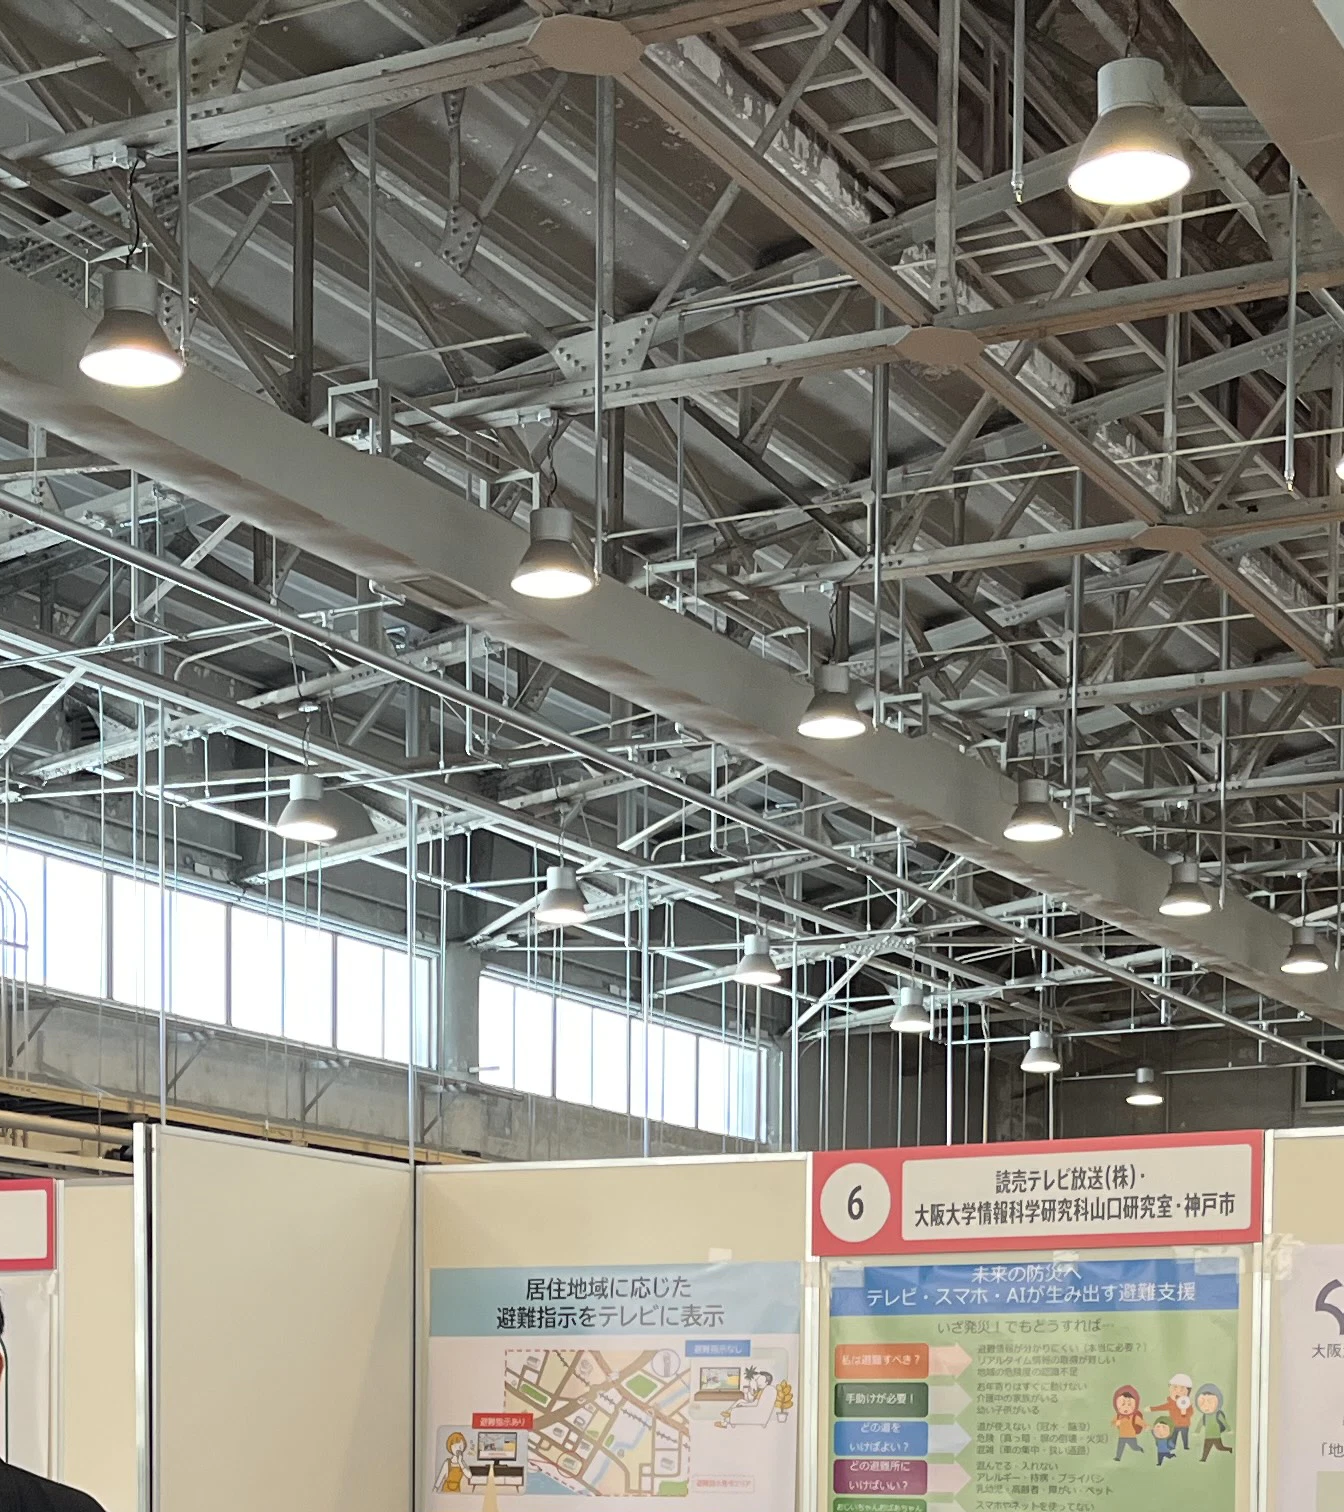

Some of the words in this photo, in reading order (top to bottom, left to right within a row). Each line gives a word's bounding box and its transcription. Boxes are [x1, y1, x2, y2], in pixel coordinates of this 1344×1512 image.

[847, 1184, 864, 1220] 6
[971, 1265, 1082, 1283] 未来の防災へ
[526, 1275, 692, 1301] 居住地域に応じた
[496, 1304, 725, 1330] 避難指示をテレビに表示
